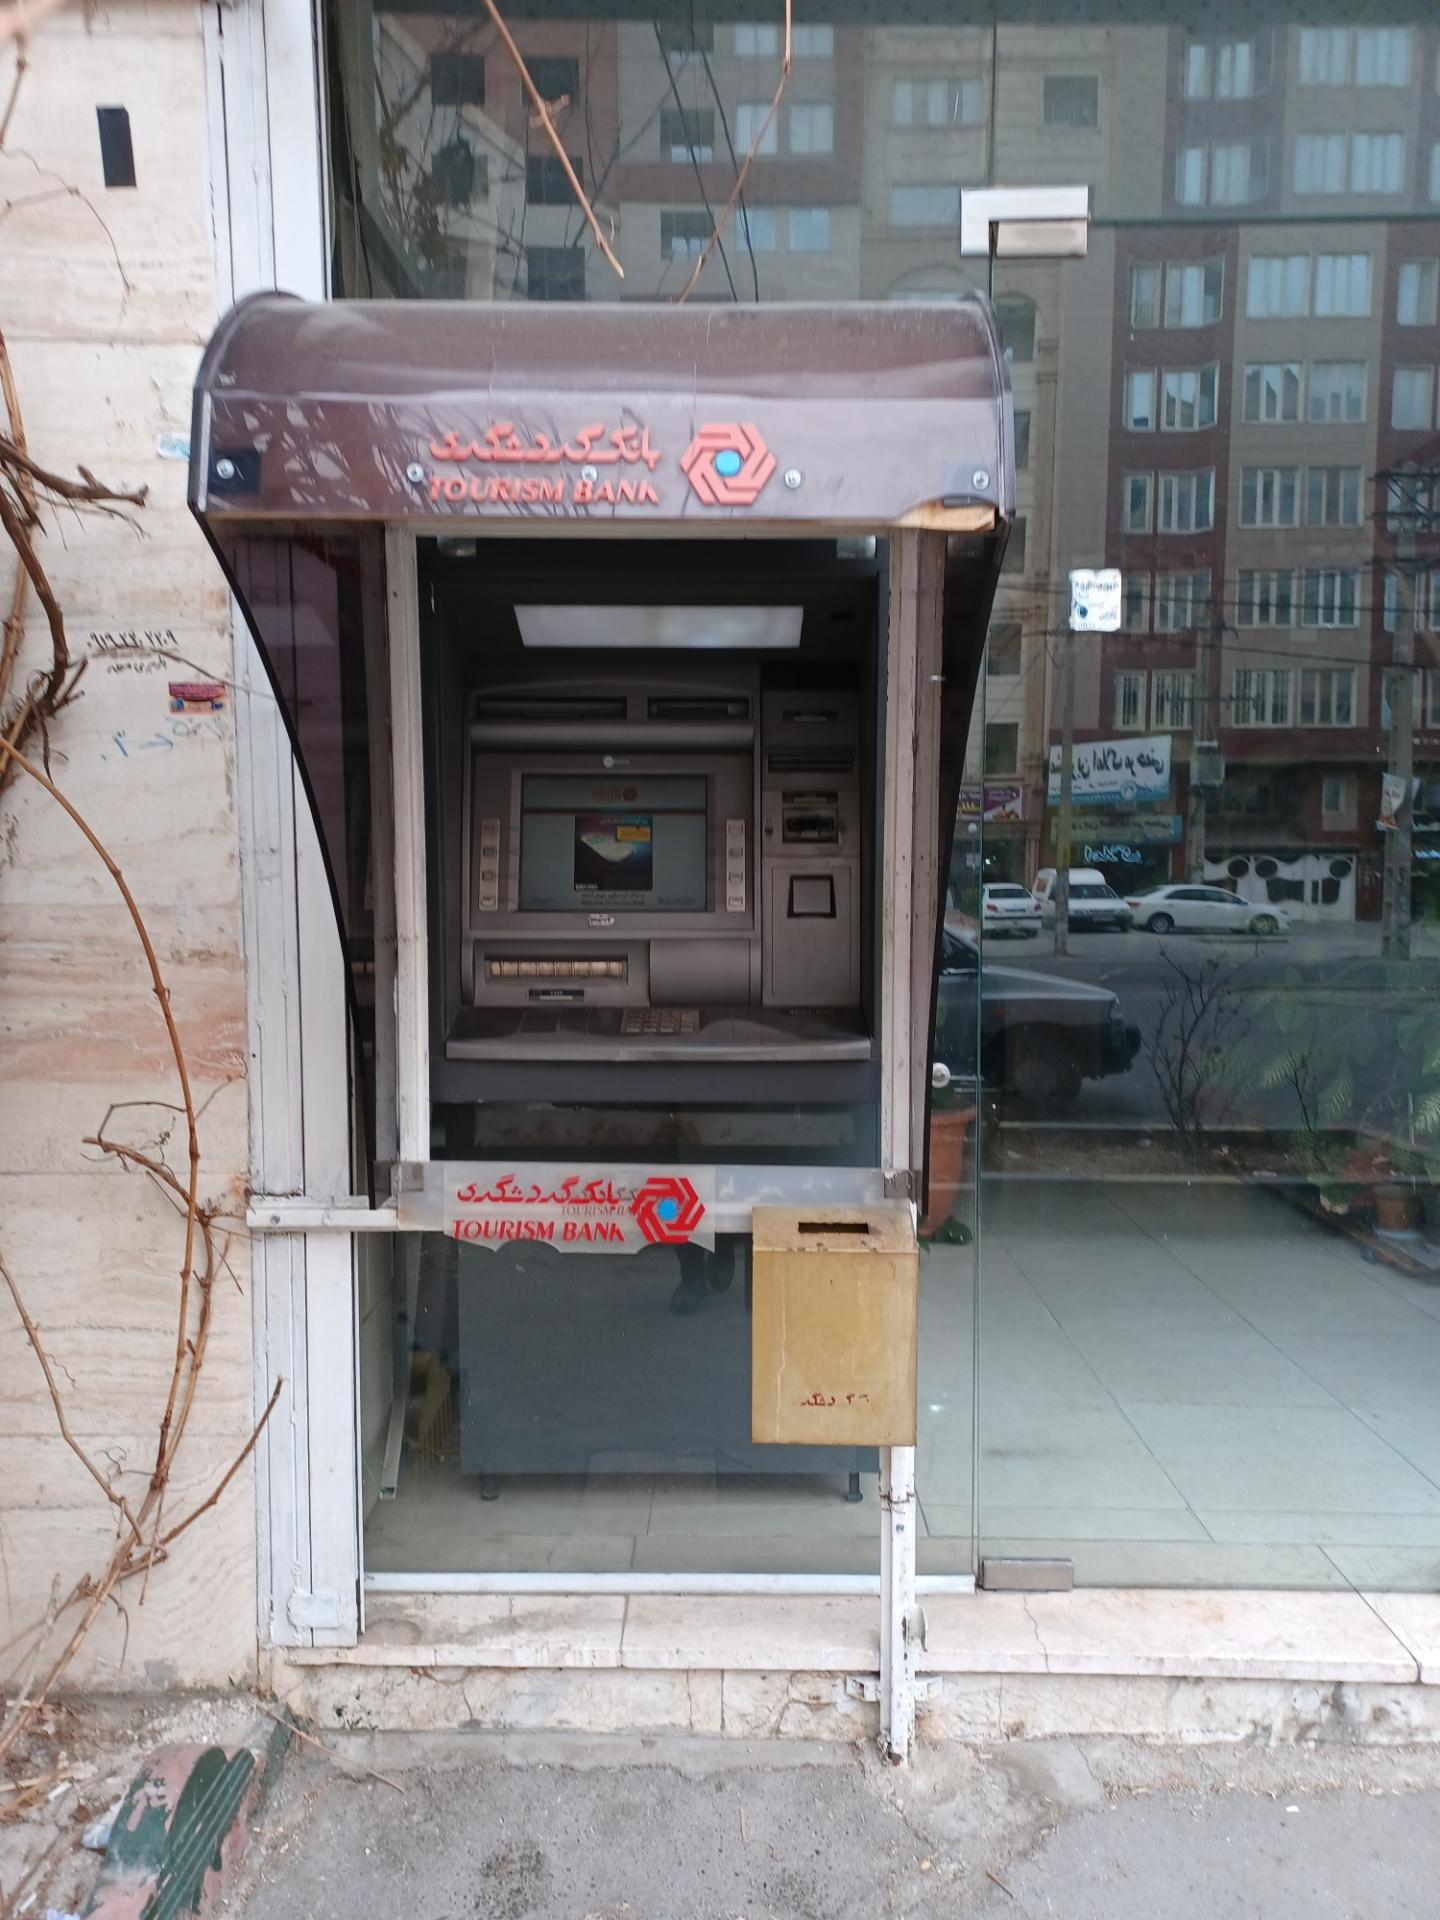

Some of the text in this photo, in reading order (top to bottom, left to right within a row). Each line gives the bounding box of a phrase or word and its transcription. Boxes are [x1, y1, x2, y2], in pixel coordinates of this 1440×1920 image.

[430, 423, 605, 463] گردشگری
[430, 477, 659, 507] TOURISM BANK
[457, 1174, 580, 1203] گردشگری
[453, 1219, 625, 1243] TOURISM BANK
